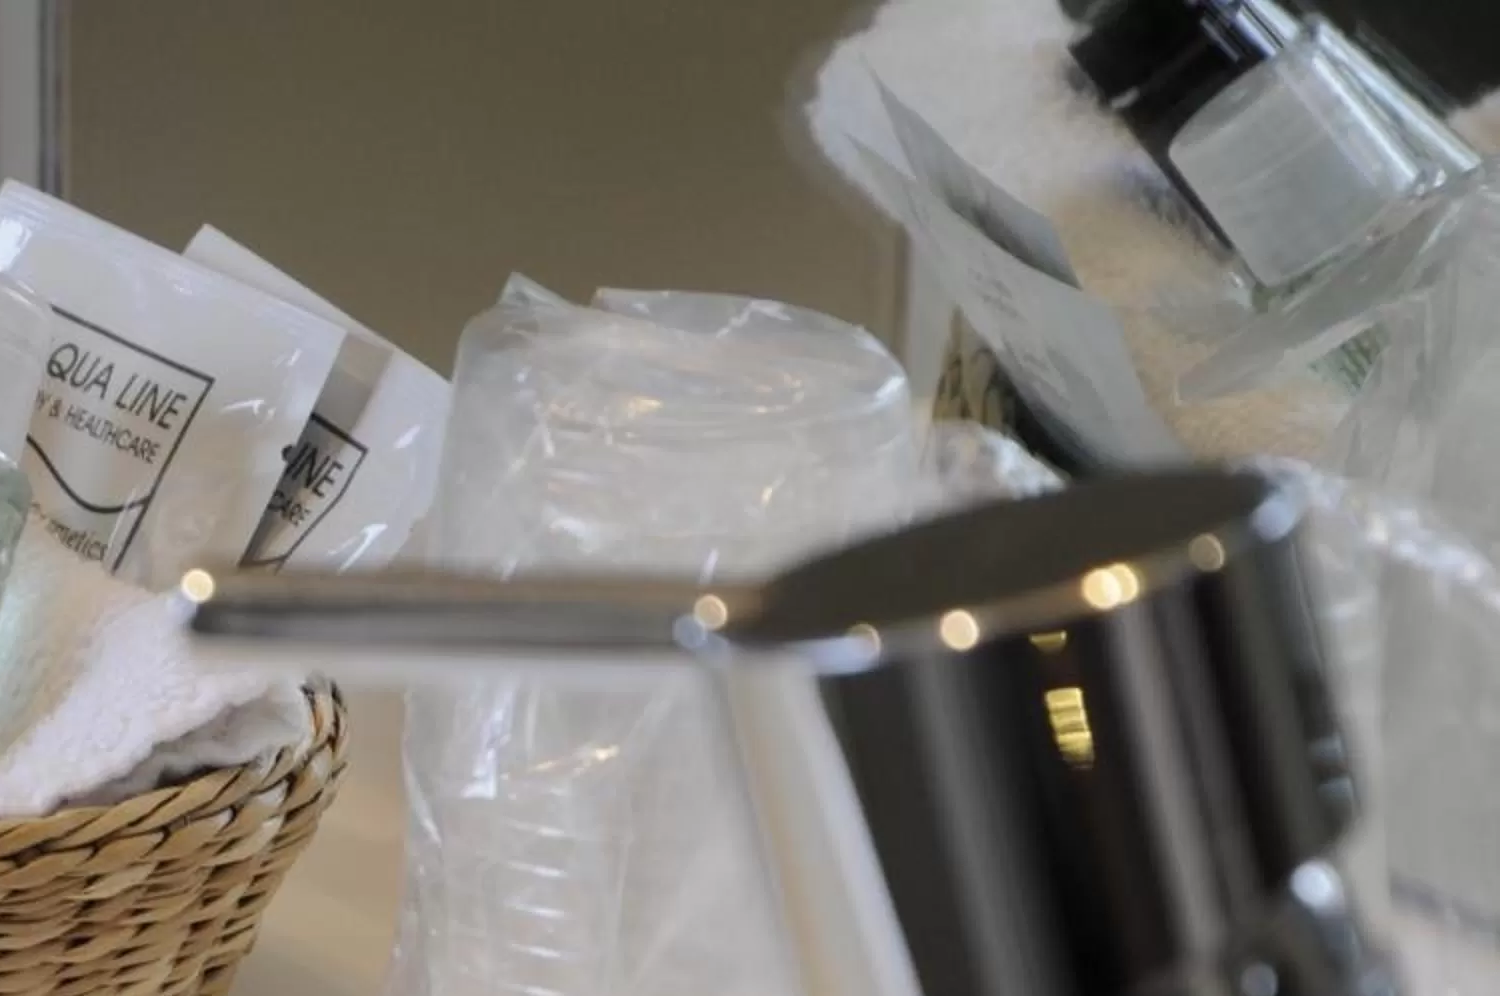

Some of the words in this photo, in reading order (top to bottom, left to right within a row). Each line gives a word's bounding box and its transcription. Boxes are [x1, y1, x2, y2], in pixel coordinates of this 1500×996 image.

[47, 343, 114, 399] QUA
[114, 373, 188, 430] LINE
[63, 404, 160, 464] HEALTHCARE
[284, 441, 345, 499] INE
